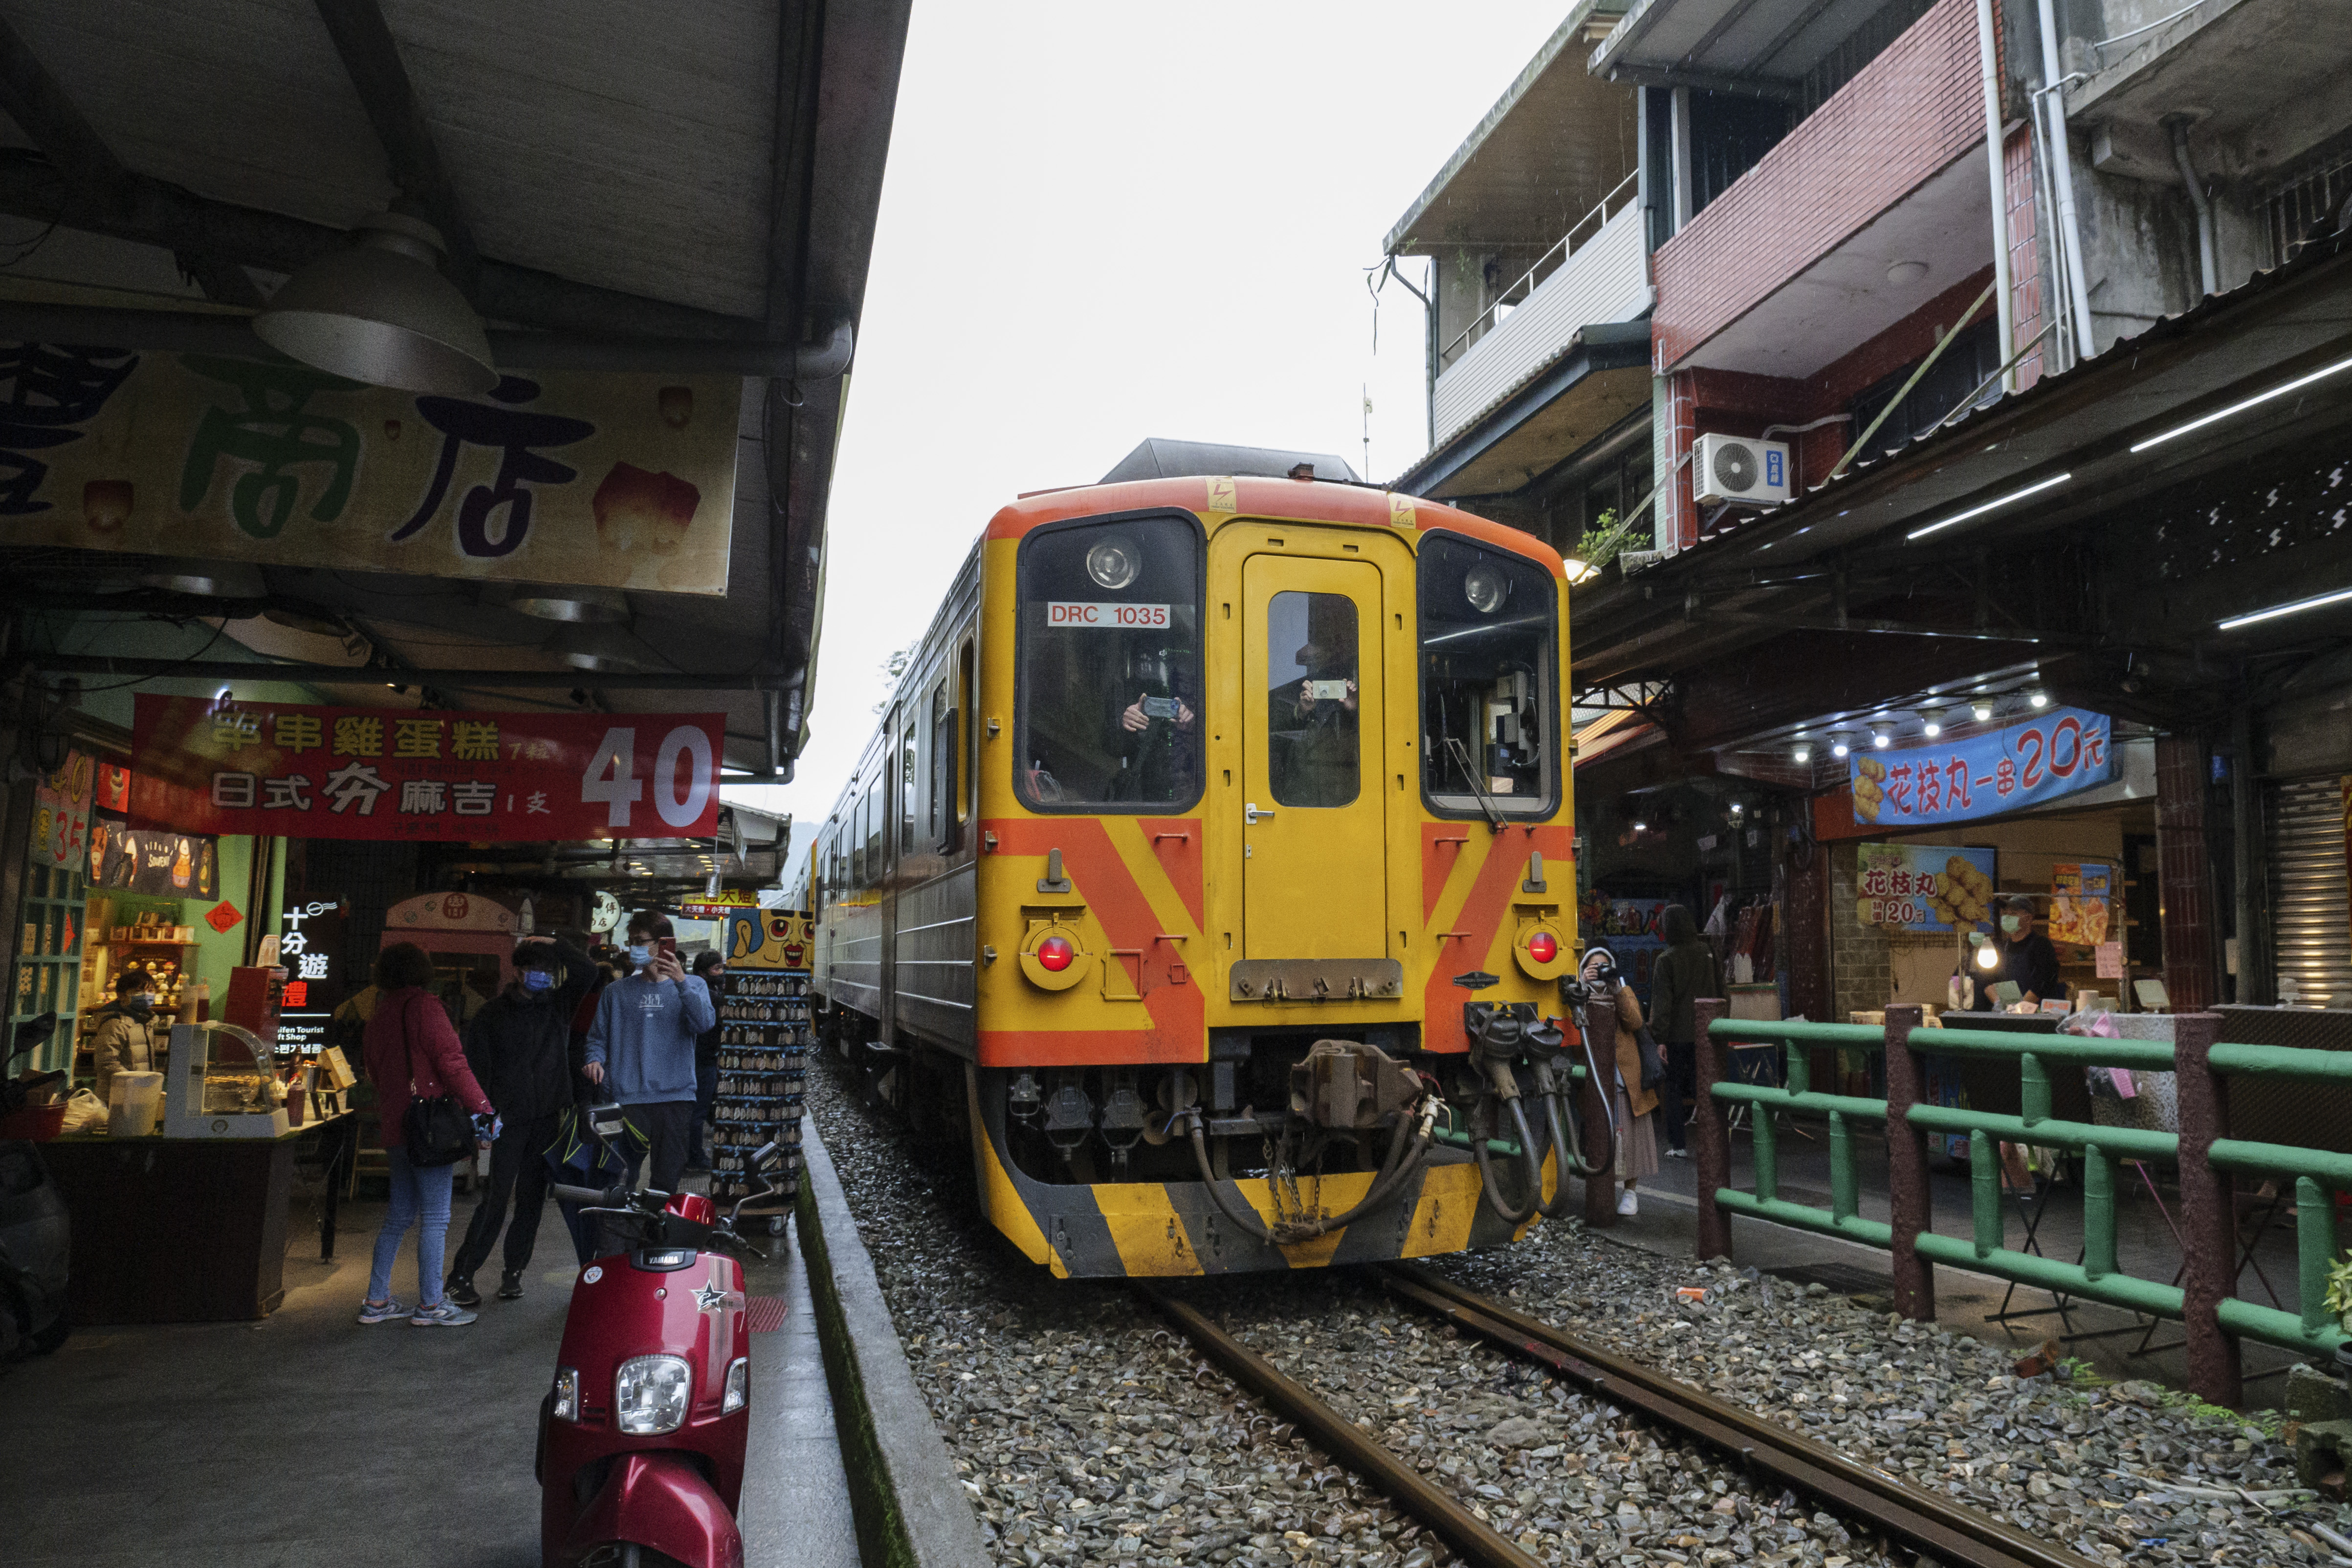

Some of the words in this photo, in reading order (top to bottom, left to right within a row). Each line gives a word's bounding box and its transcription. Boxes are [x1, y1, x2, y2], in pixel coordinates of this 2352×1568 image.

[1052, 605, 1098, 623] DRC
[1114, 607, 1166, 625] 1035
[212, 710, 499, 761] 串串雞蛋糕
[212, 761, 497, 816] 日式夯麻吉
[581, 725, 713, 828] 40
[1887, 716, 2105, 815] 花枝丸一串20元
[53, 811, 85, 862] 35
[1865, 868, 1937, 897] 花枝丸
[286, 1033, 307, 1042] Shop
[649, 1256, 679, 1264] YAMAHA
